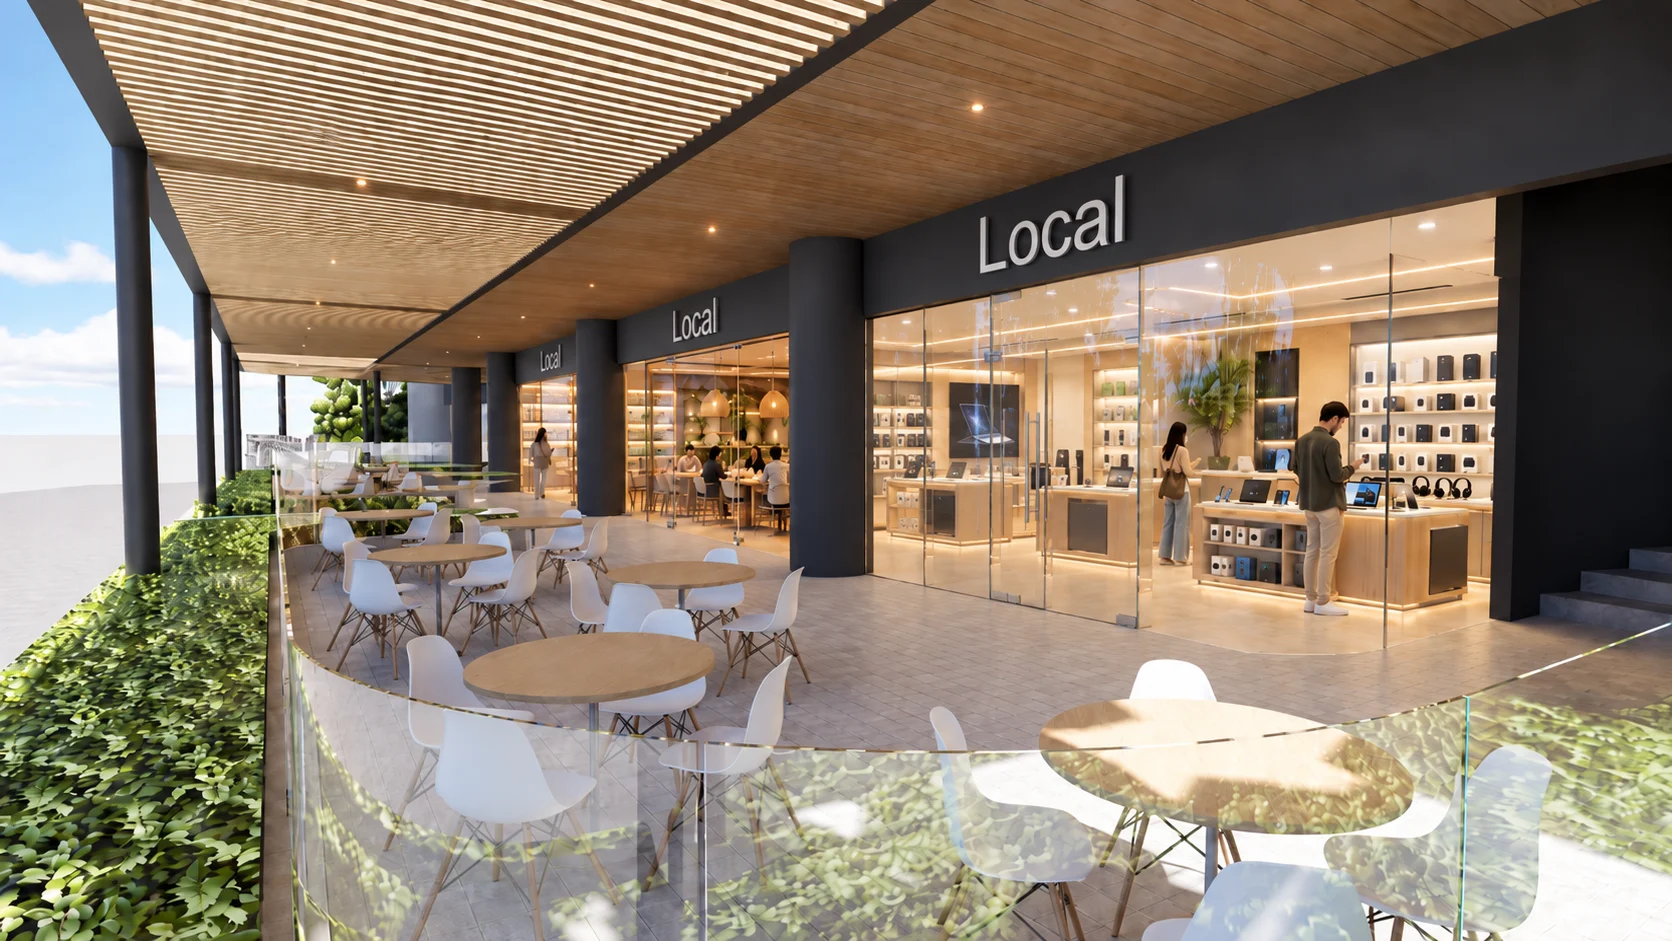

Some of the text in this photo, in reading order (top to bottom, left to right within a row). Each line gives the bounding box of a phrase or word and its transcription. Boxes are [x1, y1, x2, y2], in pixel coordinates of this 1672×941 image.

[979, 174, 1126, 274] Local
[672, 297, 719, 343] Local
[540, 344, 562, 372] Local
